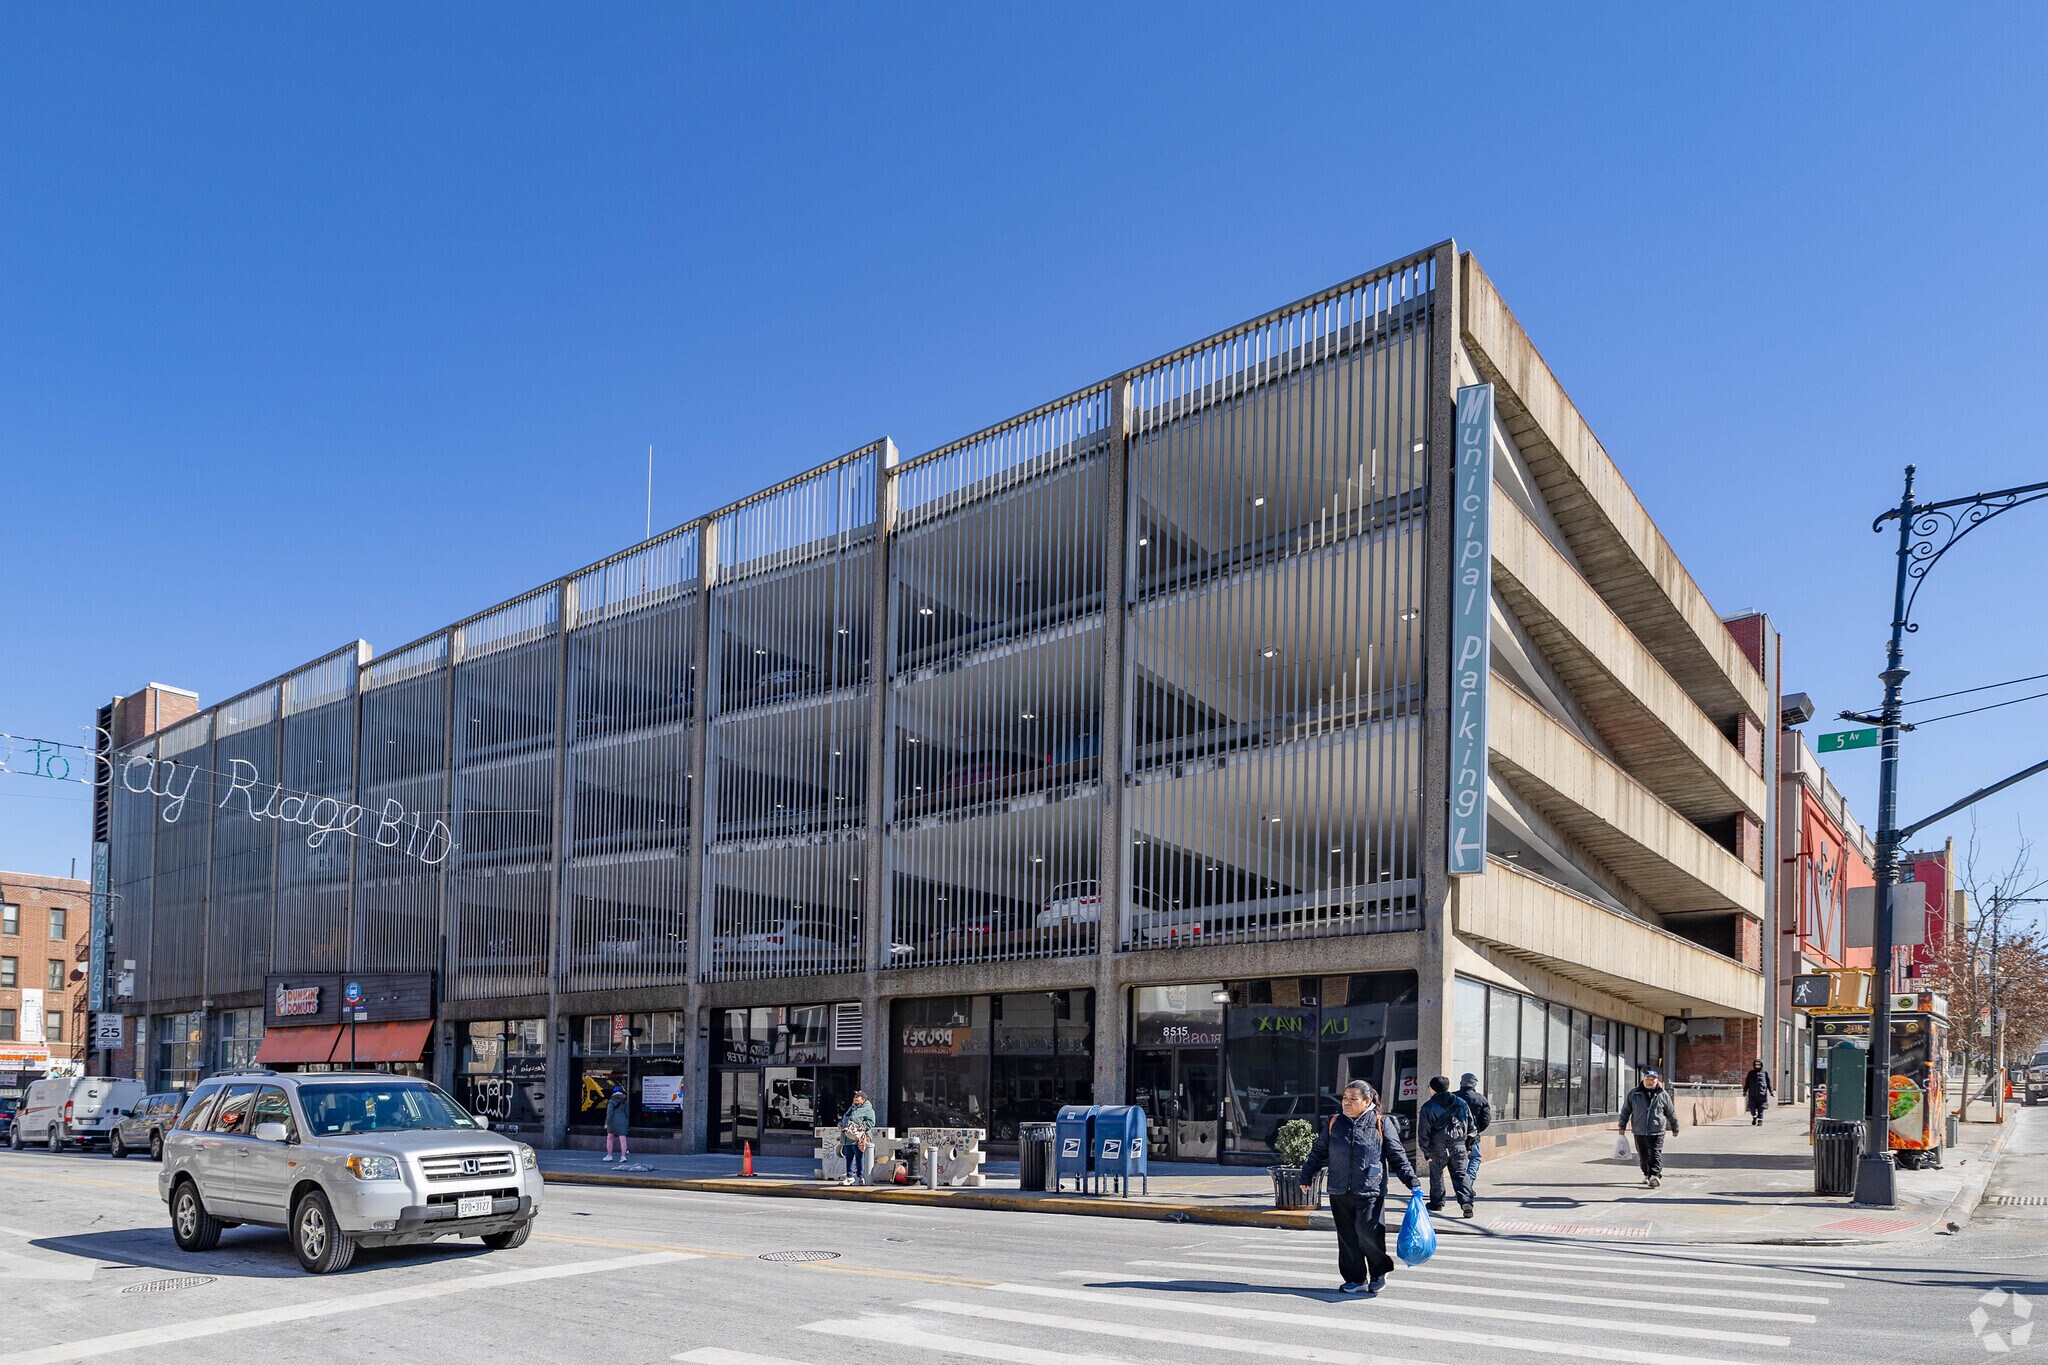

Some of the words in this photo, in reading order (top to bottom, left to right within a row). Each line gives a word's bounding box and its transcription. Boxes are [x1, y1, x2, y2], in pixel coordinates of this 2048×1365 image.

[1458, 388, 1486, 617] Municipal
[1454, 635, 1483, 818] Parking
[1837, 734, 1845, 749] 5
[1849, 732, 1860, 741] Av
[25, 739, 70, 780] to
[79, 726, 198, 823] Bay
[219, 759, 363, 848] Ridge
[376, 798, 452, 864] BID
[287, 1001, 318, 1015] DONUTS
[100, 1027, 120, 1038] 25
[1163, 1026, 1188, 1036] 8515
